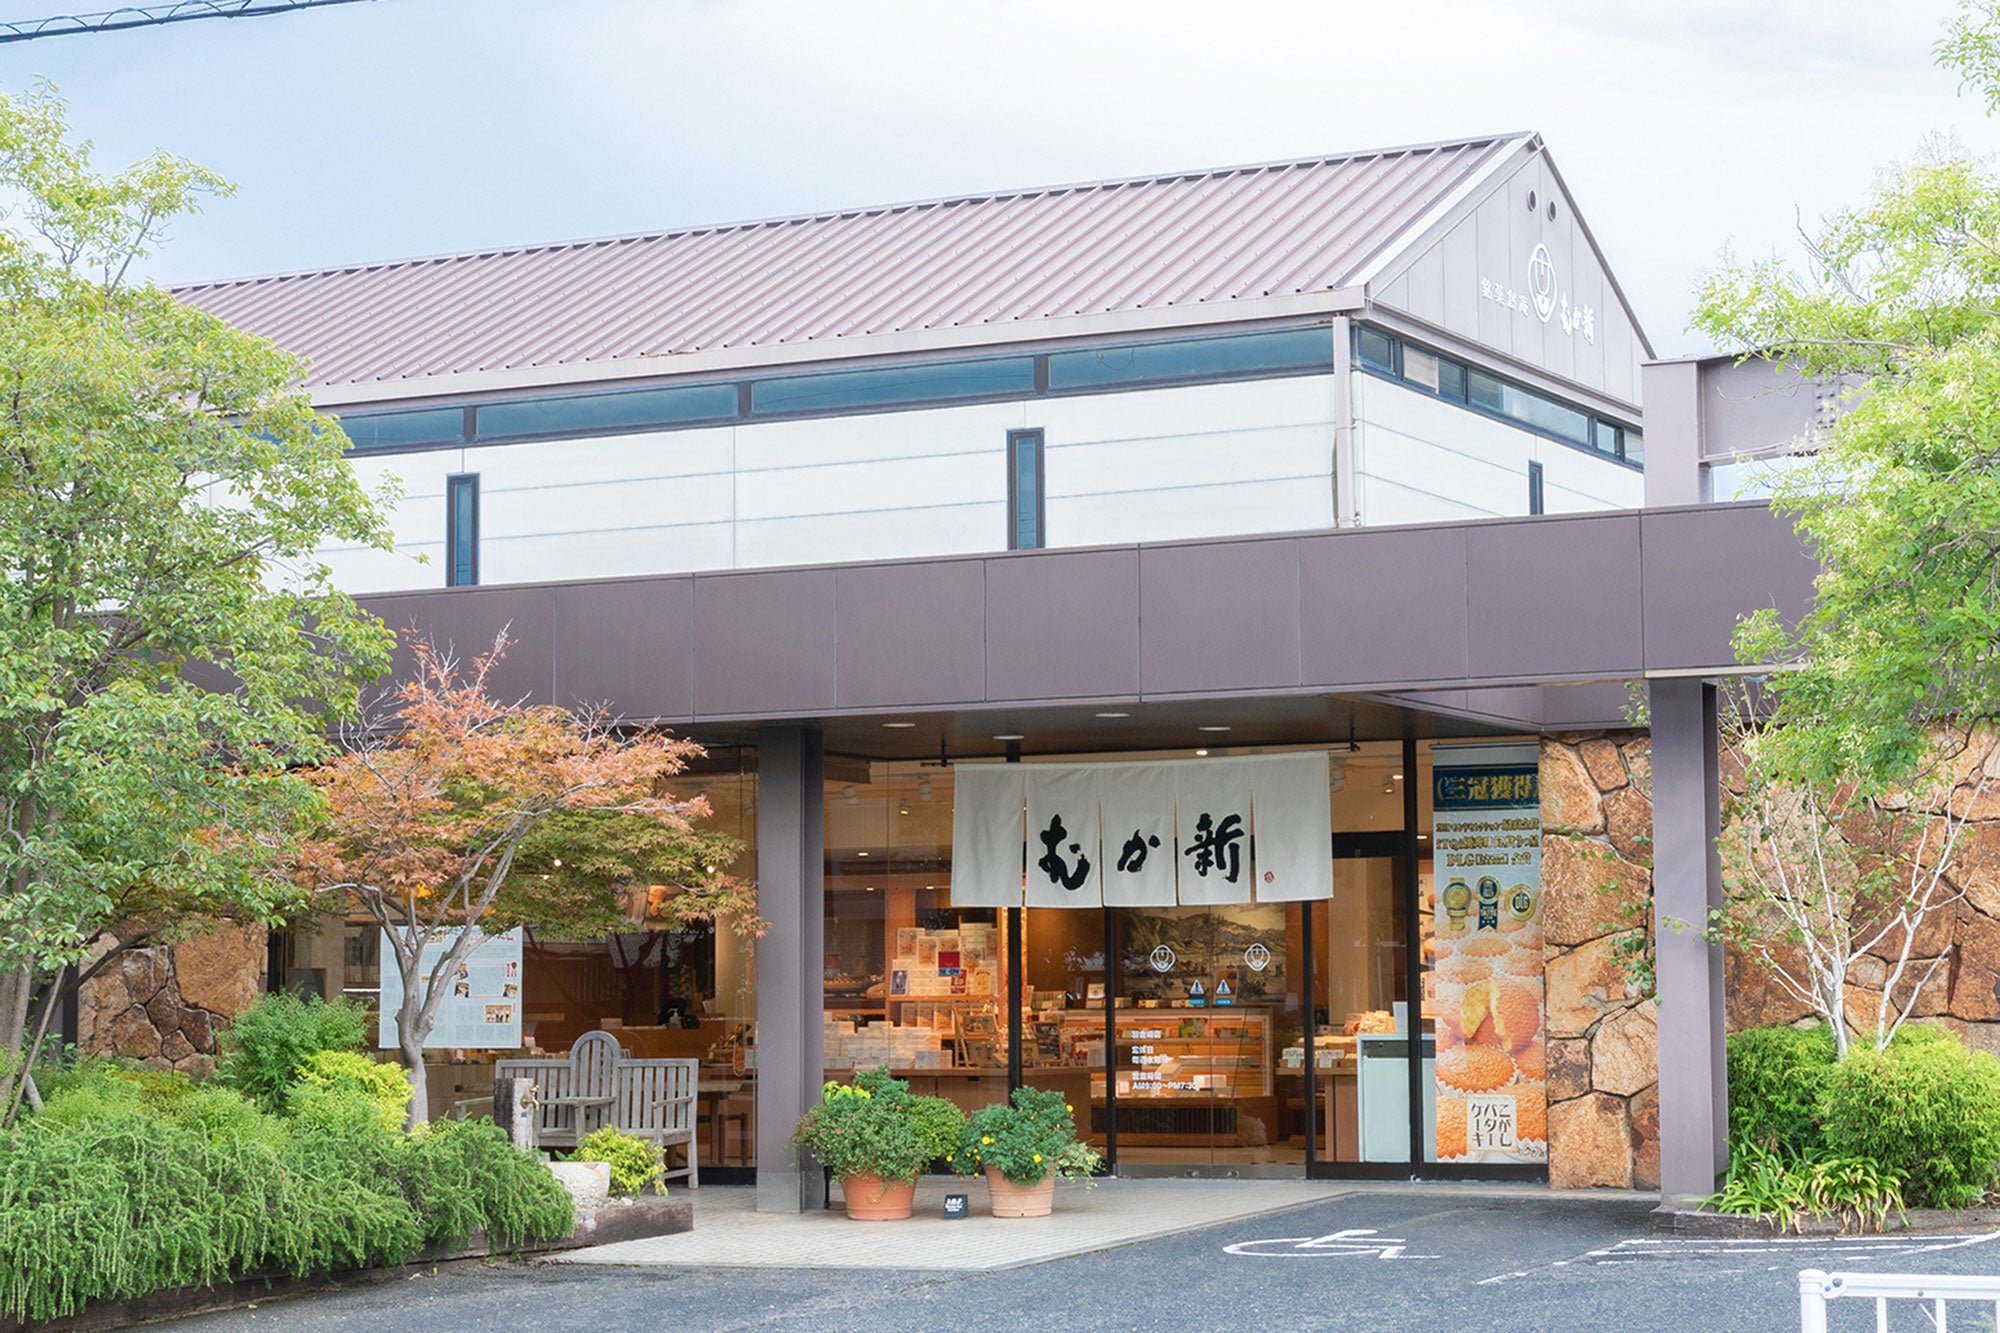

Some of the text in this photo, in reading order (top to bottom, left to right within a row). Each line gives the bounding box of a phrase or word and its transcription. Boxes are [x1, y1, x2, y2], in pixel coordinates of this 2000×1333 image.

[1038, 813, 1246, 891] むか新
[1471, 1103, 1484, 1147] ケーキ
[1499, 1103, 1512, 1147] こがし
